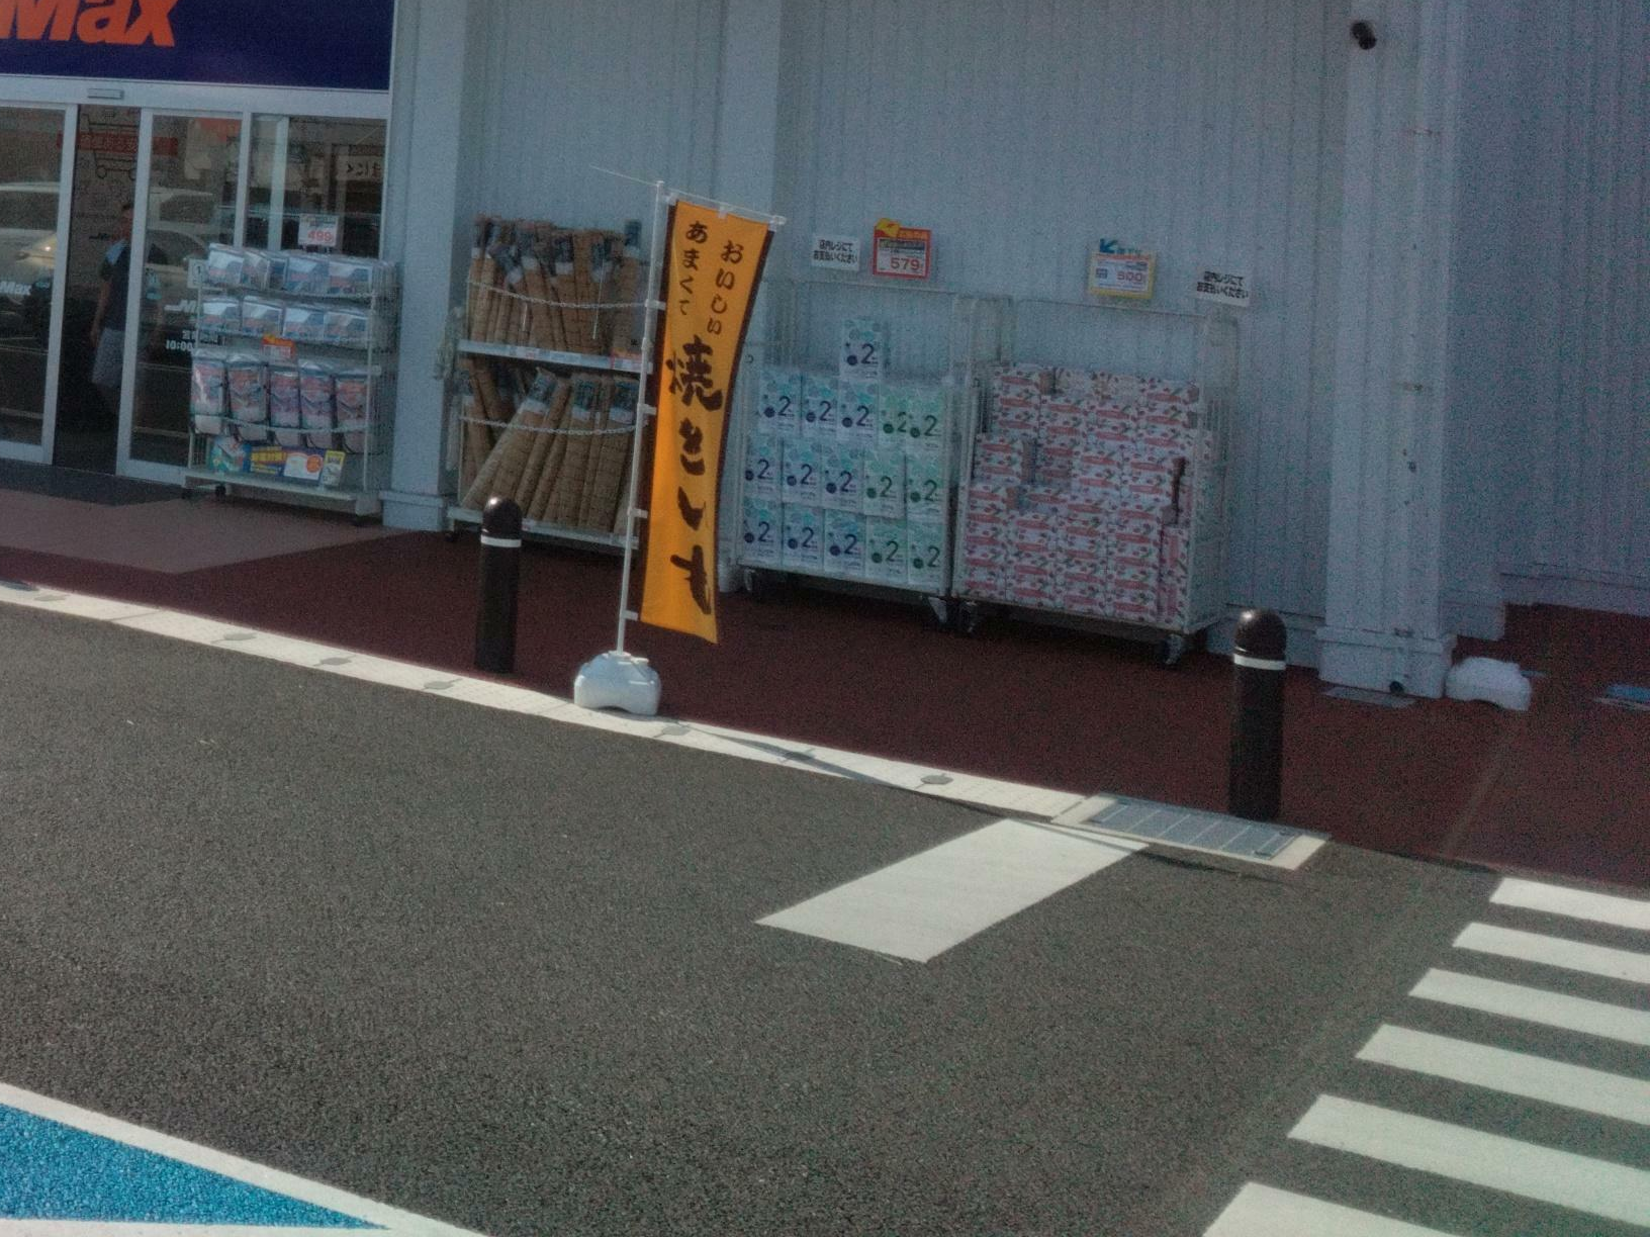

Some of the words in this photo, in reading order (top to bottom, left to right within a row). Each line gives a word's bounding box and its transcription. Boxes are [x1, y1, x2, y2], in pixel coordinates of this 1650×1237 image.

[679, 220, 709, 317] あまくて
[890, 257, 920, 271] 579
[707, 239, 744, 336] おいしい
[861, 343, 875, 364] 2
[778, 396, 791, 417] 2
[819, 400, 832, 422] 2
[856, 405, 869, 427] 2
[924, 415, 938, 437] 2
[757, 459, 770, 480] 2
[800, 464, 813, 485] 2
[840, 471, 853, 493] 2
[880, 476, 893, 498] 2
[924, 479, 938, 502] 2
[758, 521, 771, 543] 2
[801, 527, 814, 548] 2
[844, 534, 858, 555] 2
[886, 540, 899, 562] 2
[927, 546, 941, 568] 2
